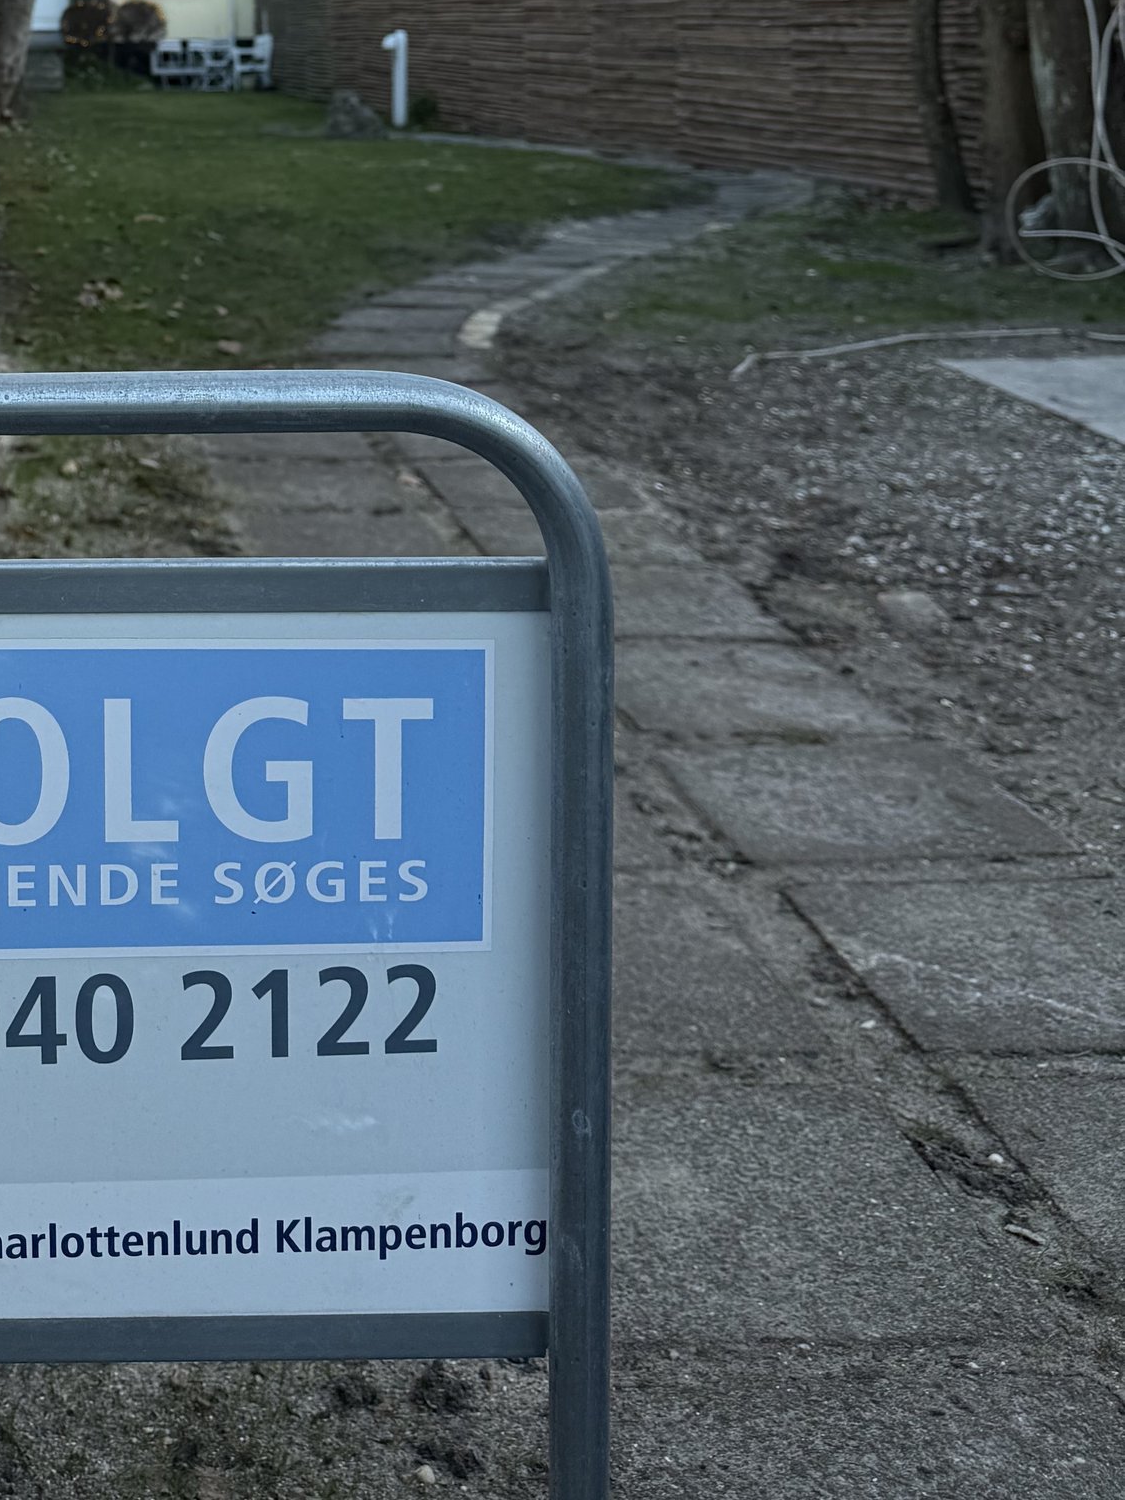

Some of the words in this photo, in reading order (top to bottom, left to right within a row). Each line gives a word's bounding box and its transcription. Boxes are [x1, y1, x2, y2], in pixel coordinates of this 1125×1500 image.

[213, 859, 430, 905] SØGES
[180, 964, 439, 1063] 2122
[275, 1213, 547, 1257] Klampenborg
